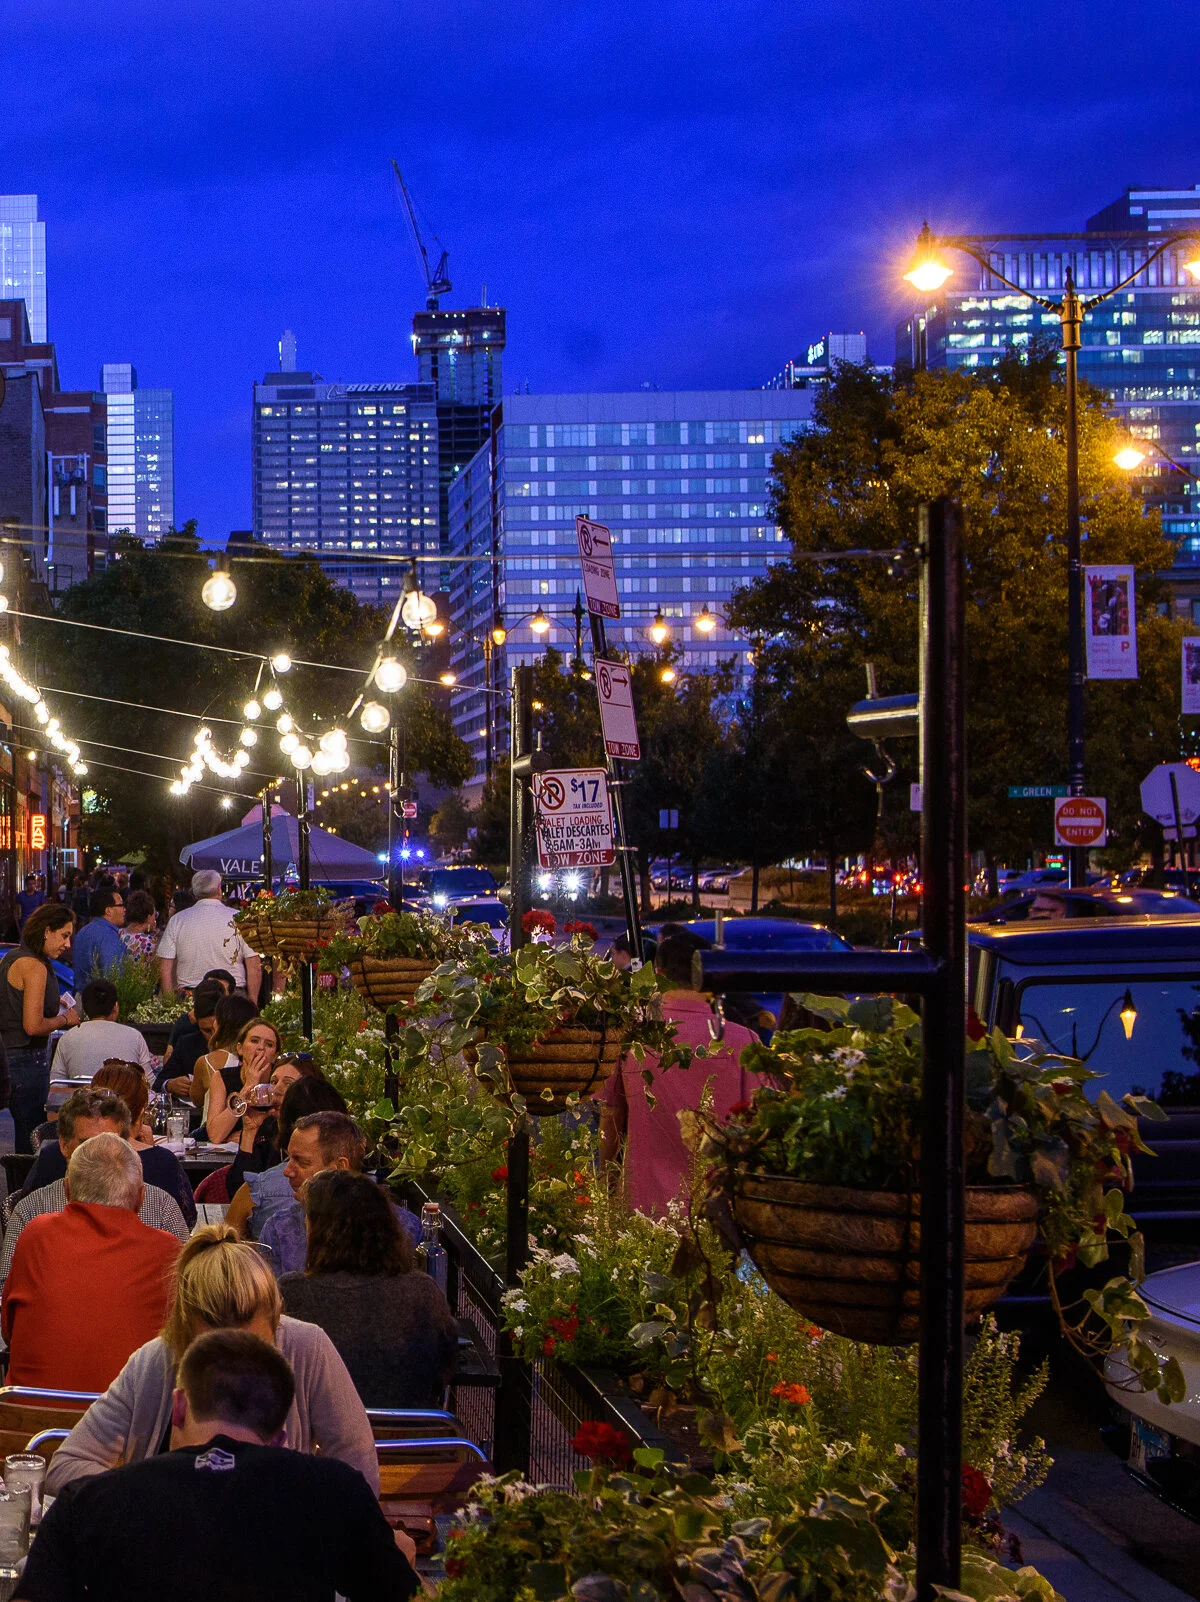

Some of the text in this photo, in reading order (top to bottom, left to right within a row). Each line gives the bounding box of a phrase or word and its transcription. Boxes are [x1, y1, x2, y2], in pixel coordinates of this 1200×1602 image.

[346, 383, 407, 392] BOEING
[589, 597, 618, 618] TOW ZONE
[607, 742, 638, 757] TOW ZONE
[570, 777, 600, 803] $17
[1022, 787, 1052, 797] GREEN
[1062, 807, 1097, 815] DO NOT
[569, 815, 603, 826] LOADING
[31, 815, 46, 850] BAR
[566, 823, 610, 838] DESCARTES
[1066, 828, 1094, 837] ENTER
[576, 850, 608, 865] ZONE
[220, 858, 261, 874] VALE
